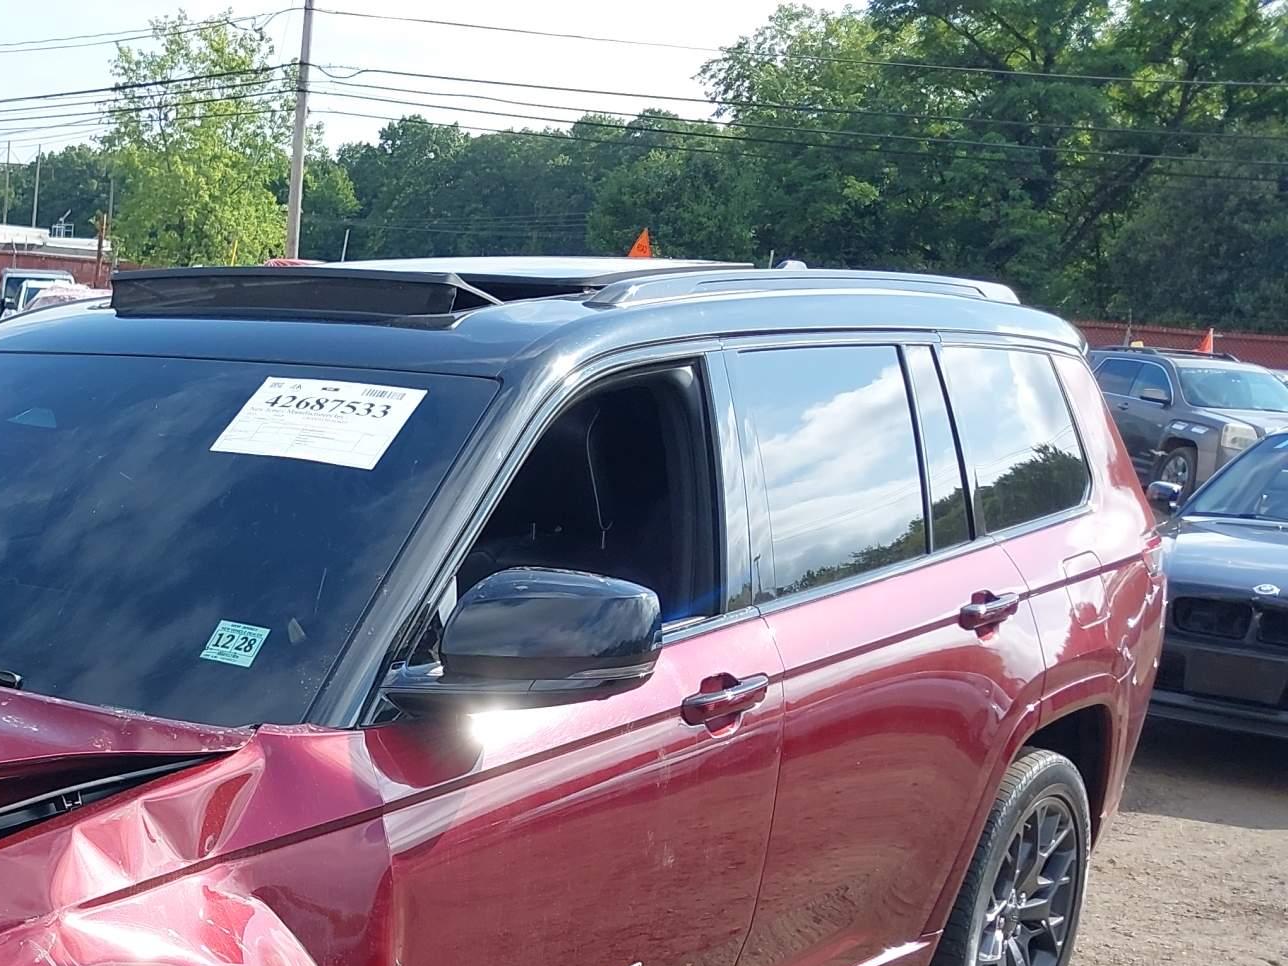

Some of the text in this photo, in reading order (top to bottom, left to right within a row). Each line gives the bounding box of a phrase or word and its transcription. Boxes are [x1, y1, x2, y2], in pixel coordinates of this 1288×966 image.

[264, 394, 393, 419] 42687533
[212, 632, 257, 653] 12 28
